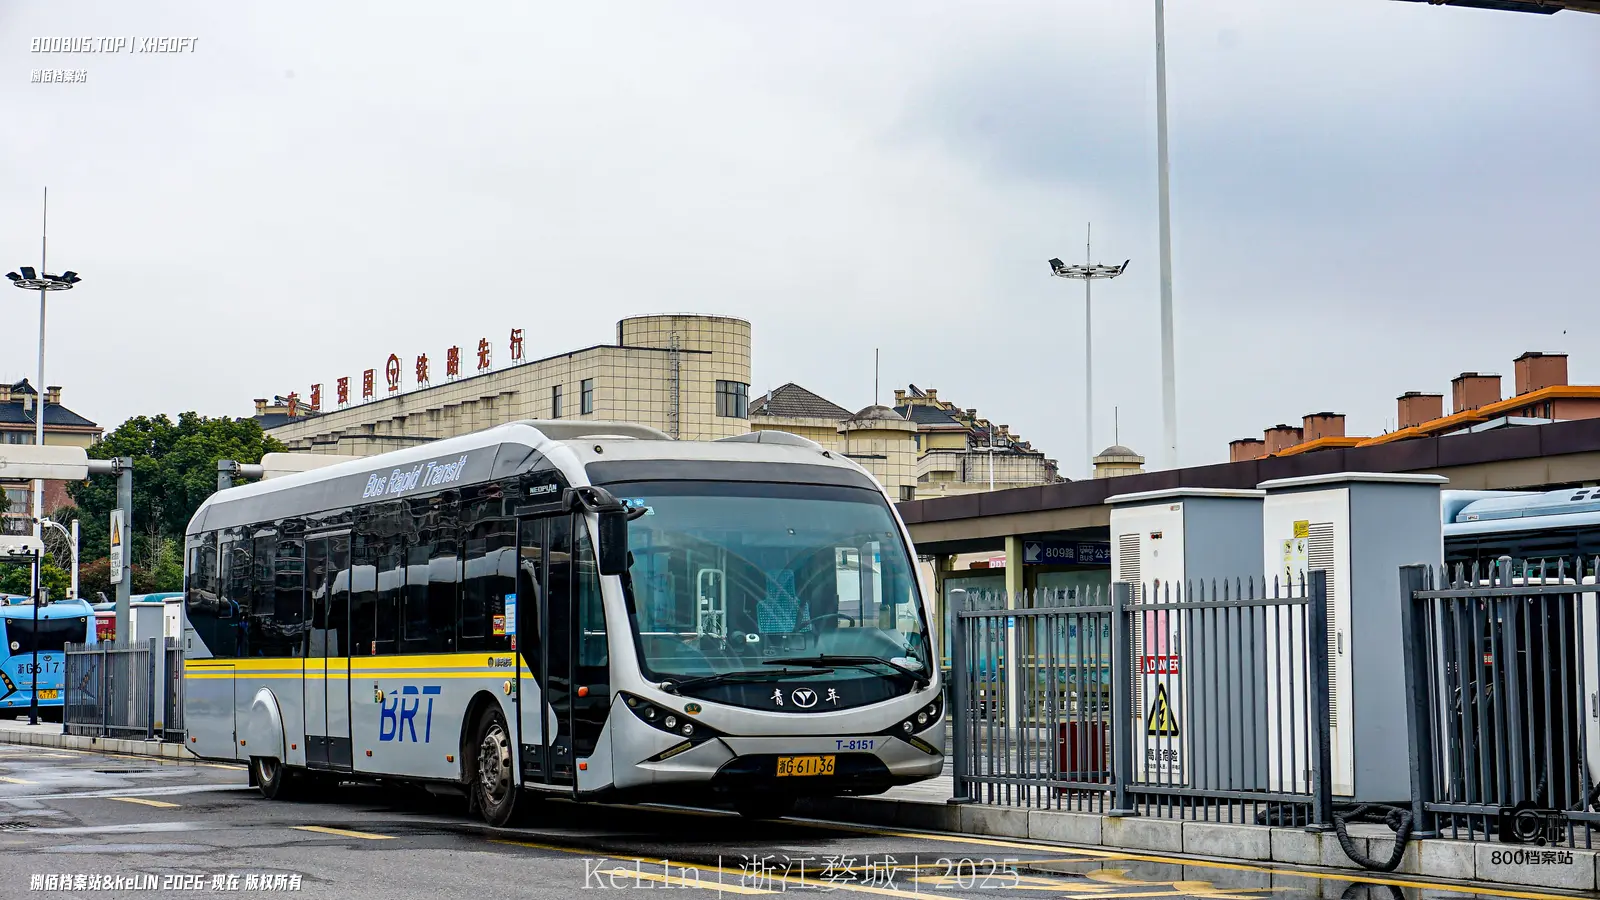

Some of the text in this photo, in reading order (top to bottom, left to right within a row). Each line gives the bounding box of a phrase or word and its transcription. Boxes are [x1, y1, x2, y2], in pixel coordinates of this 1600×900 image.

[287, 328, 523, 417] 交通强国 铁路先行
[363, 455, 468, 498] Bus Rapid Transit
[530, 484, 557, 494] NEOPLAN
[1046, 547, 1074, 558] 809路
[380, 685, 441, 743] BRT
[835, 740, 874, 750] T-8151
